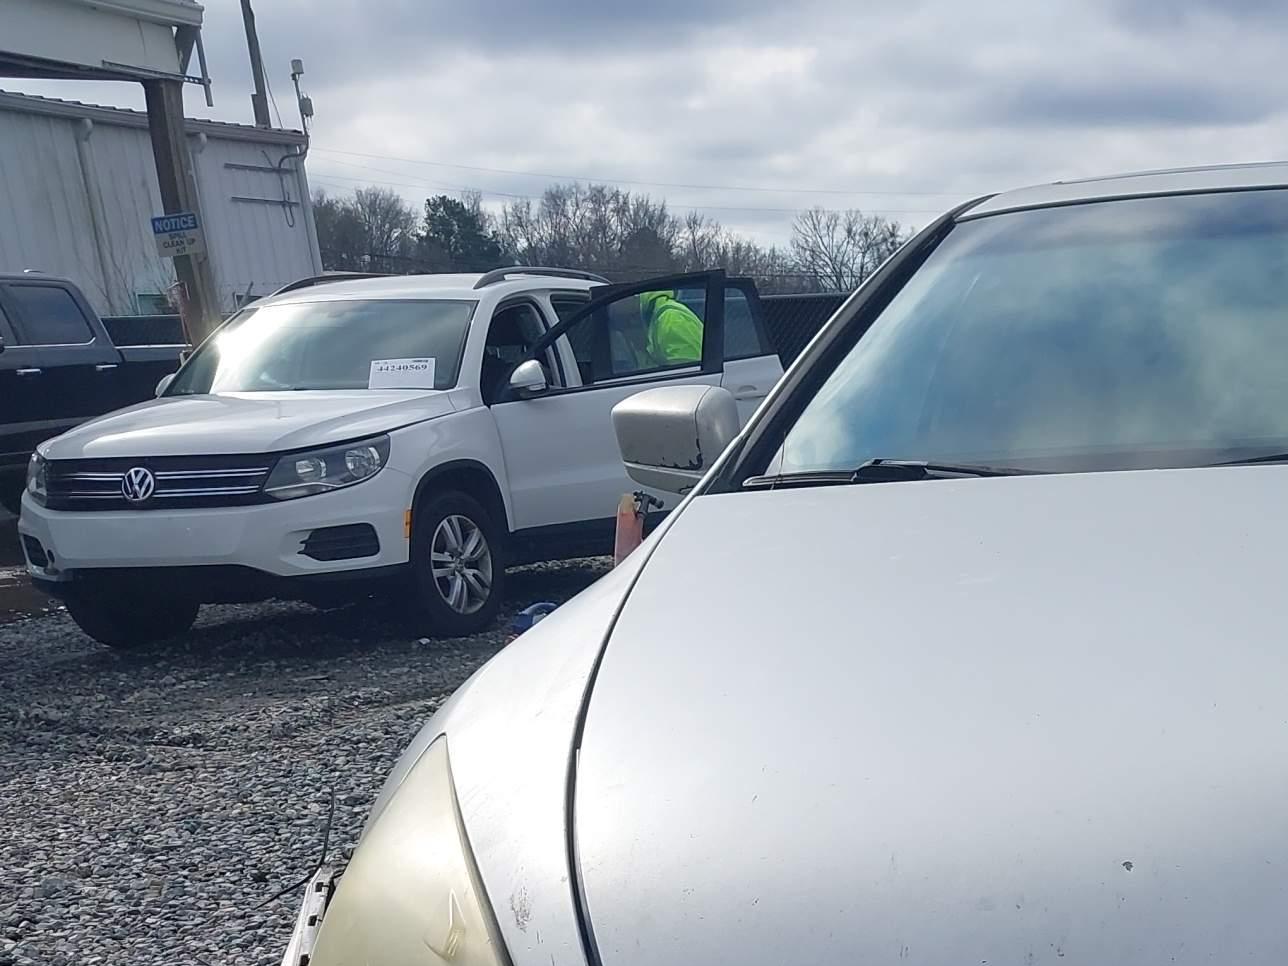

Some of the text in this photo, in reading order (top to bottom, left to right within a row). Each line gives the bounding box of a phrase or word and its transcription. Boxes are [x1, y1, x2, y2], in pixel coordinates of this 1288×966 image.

[154, 216, 195, 232] NOTICE
[162, 238, 185, 249] CLEAN
[376, 363, 428, 372] 44240569
